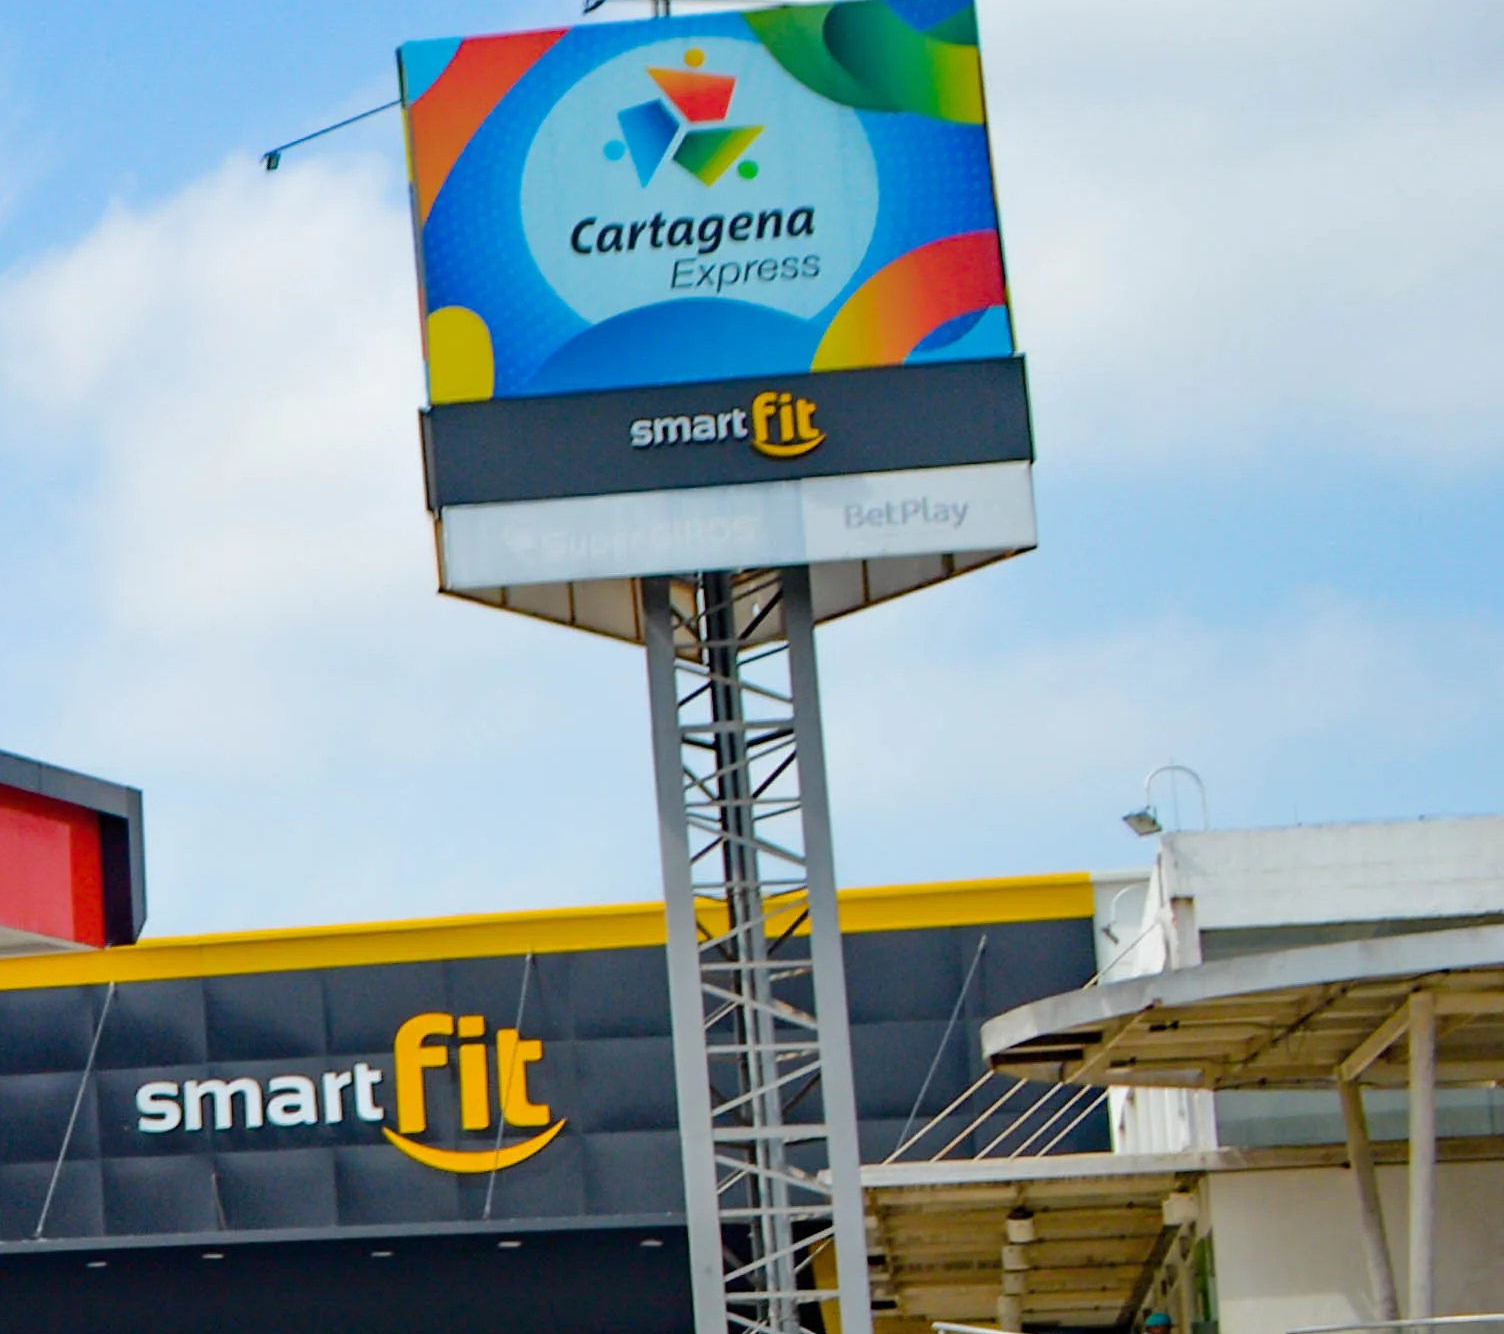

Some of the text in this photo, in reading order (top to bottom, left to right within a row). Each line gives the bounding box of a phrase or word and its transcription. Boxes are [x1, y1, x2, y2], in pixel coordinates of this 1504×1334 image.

[570, 204, 816, 255] Cartagena
[670, 252, 821, 294] Express
[631, 390, 824, 449] smart fit
[844, 497, 969, 530] BetPlay
[136, 1012, 560, 1149] smart fit
